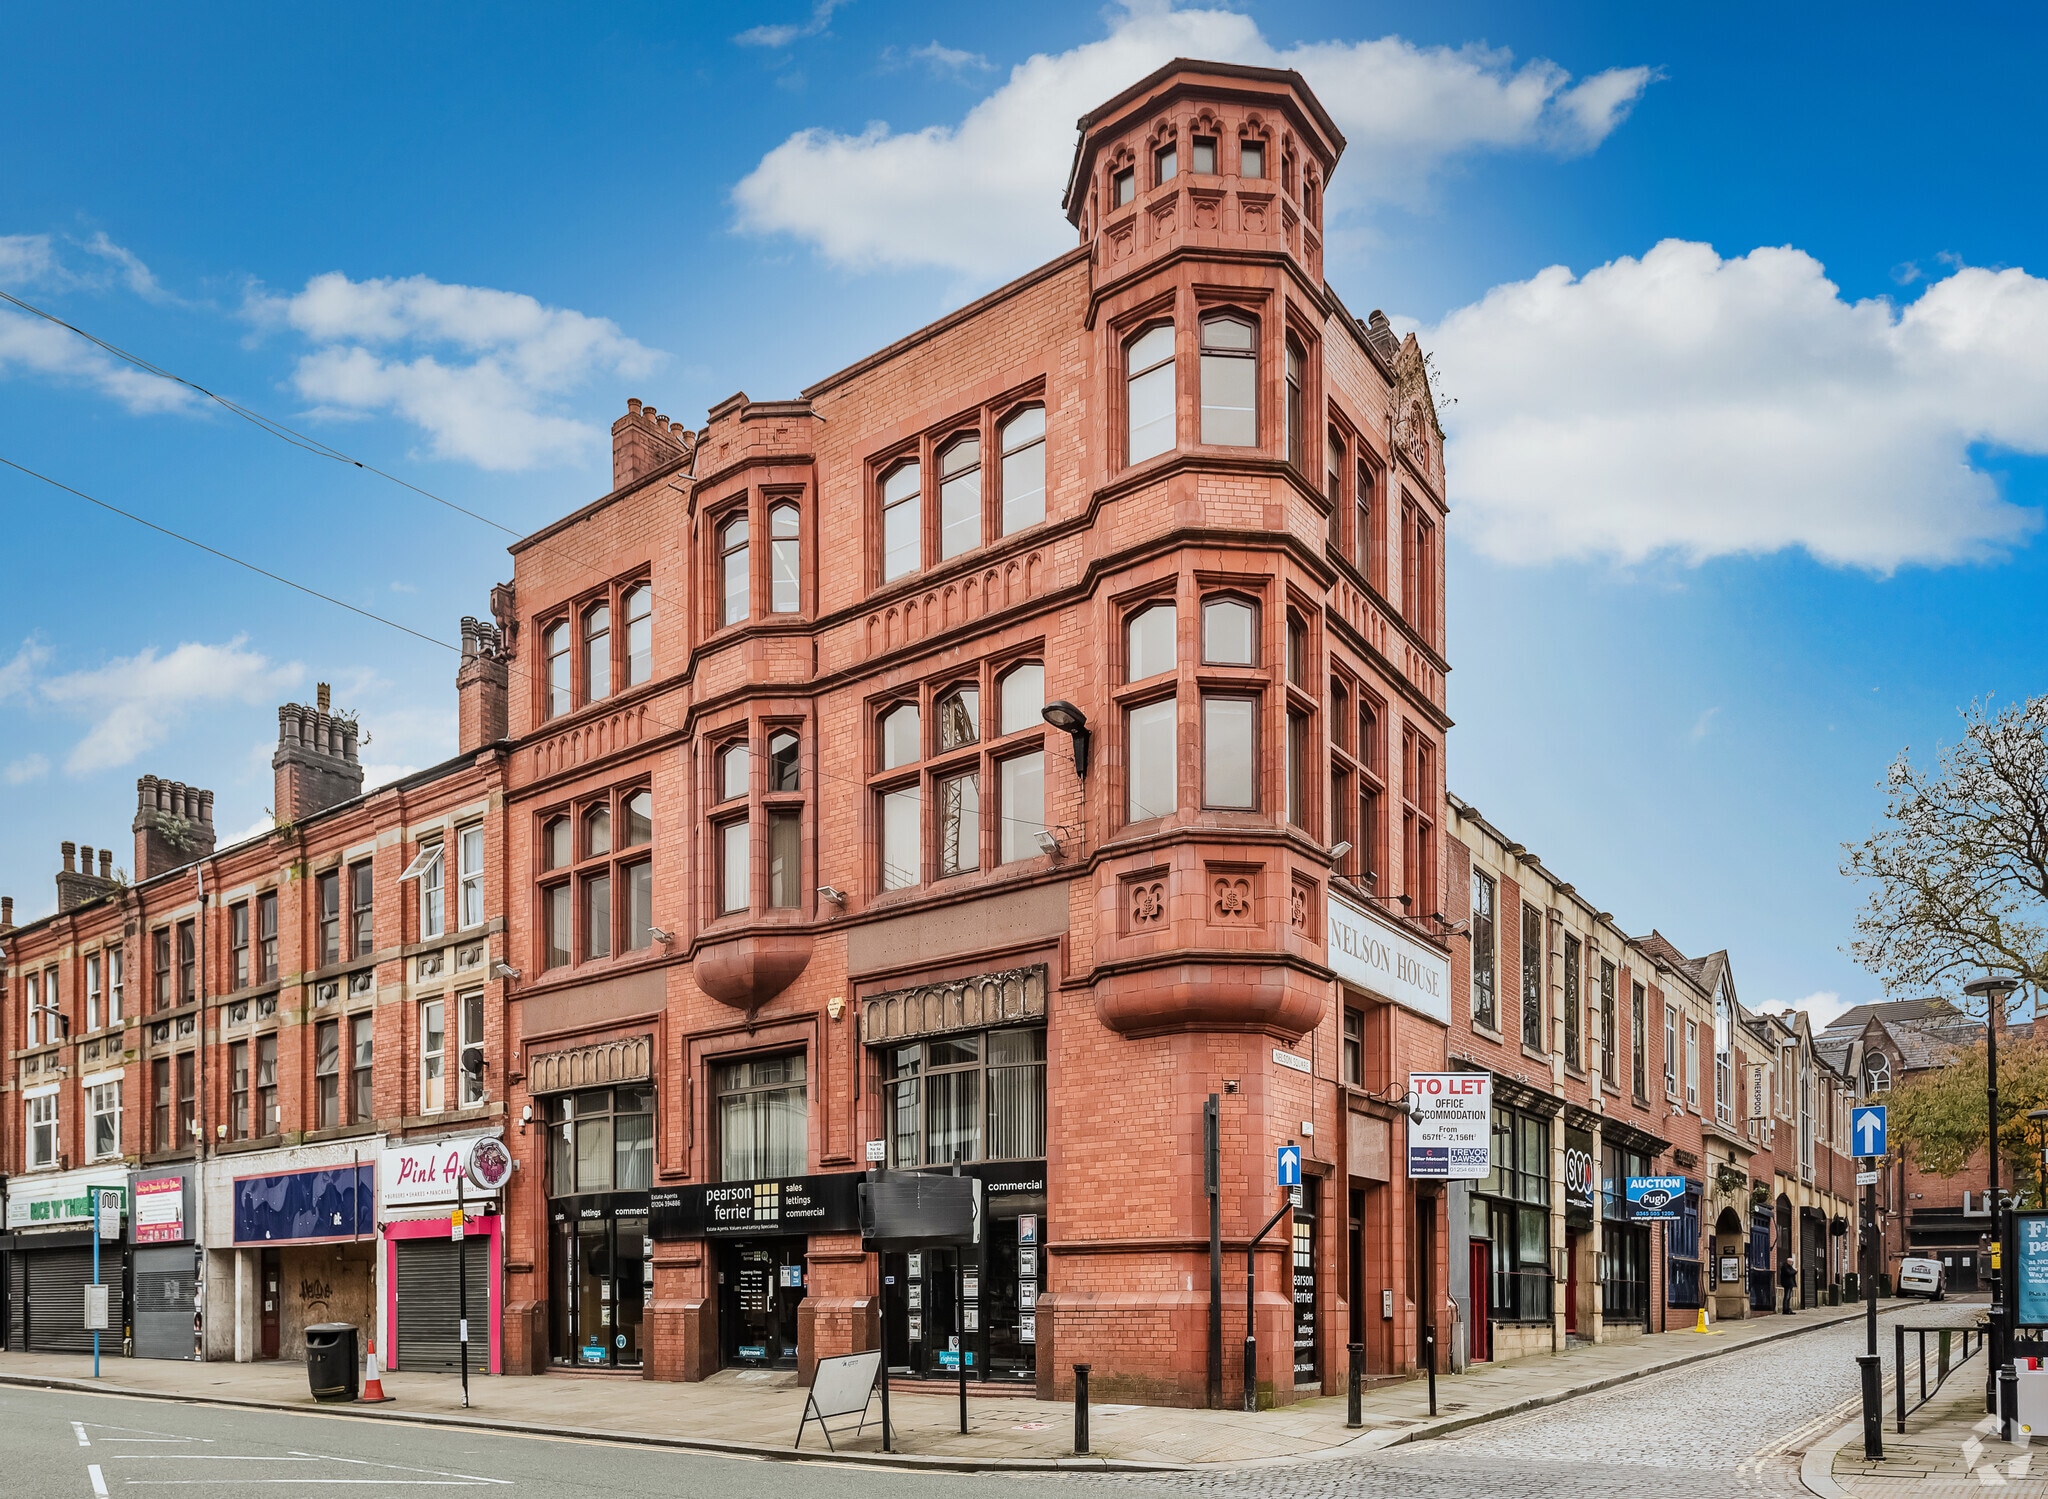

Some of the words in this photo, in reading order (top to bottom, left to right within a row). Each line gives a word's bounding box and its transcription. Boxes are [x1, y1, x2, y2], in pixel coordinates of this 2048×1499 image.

[1330, 917, 1390, 974] NELSON
[1397, 952, 1440, 998] HOUSE
[1414, 1079, 1442, 1094] TO
[1449, 1079, 1486, 1094] LET
[1754, 1067, 1762, 1116] WETHERSPOON
[1436, 1098, 1464, 1108] OFFICE
[397, 1156, 436, 1185] Pink
[1567, 1154, 1592, 1189] SYN
[785, 1183, 802, 1192] sales
[988, 1180, 1043, 1191] commercial
[1630, 1179, 1680, 1188] AUCTION
[664, 1193, 678, 1201] Agents
[706, 1186, 751, 1205] pearson
[785, 1196, 811, 1205] lettings
[1644, 1193, 1666, 1206] Pugh
[63, 1197, 89, 1217] THRE
[615, 1207, 648, 1215] commerci
[714, 1204, 751, 1220] ferrier
[785, 1207, 825, 1218] commercial
[581, 1209, 601, 1218] lettings
[1294, 1275, 1313, 1286] earson
[1294, 1289, 1313, 1303] ferrier
[1303, 1311, 1313, 1320] sales
[1298, 1325, 1313, 1335] lettings
